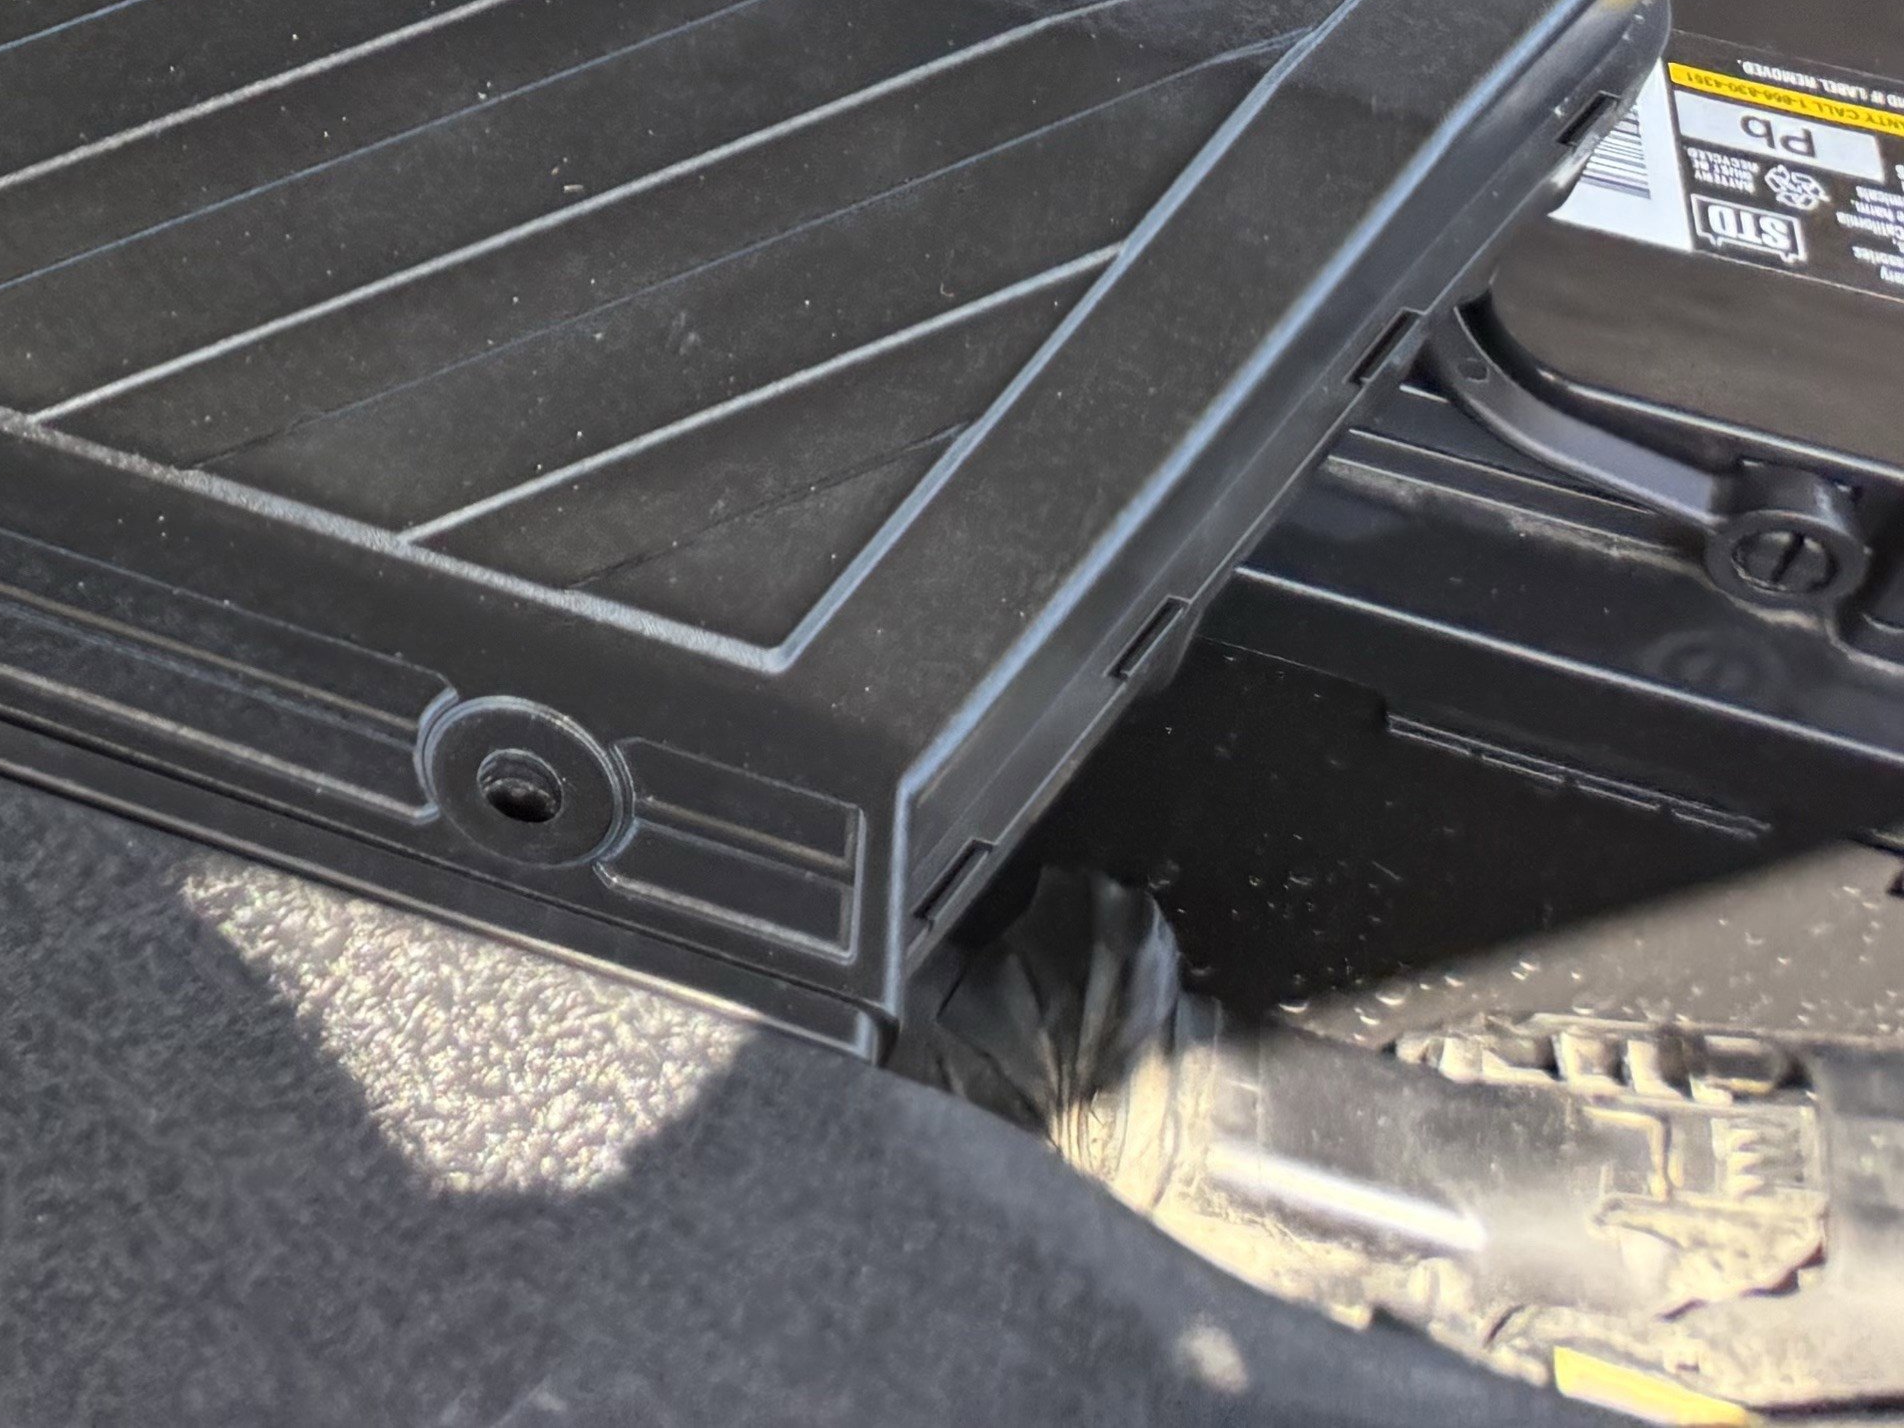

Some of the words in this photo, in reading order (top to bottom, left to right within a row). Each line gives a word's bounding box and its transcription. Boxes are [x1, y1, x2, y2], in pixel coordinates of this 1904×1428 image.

[1819, 77, 1869, 101] LABEL
[1812, 98, 1861, 121] CALL
[1741, 114, 1817, 158] Pb
[1707, 204, 1792, 251] STD
